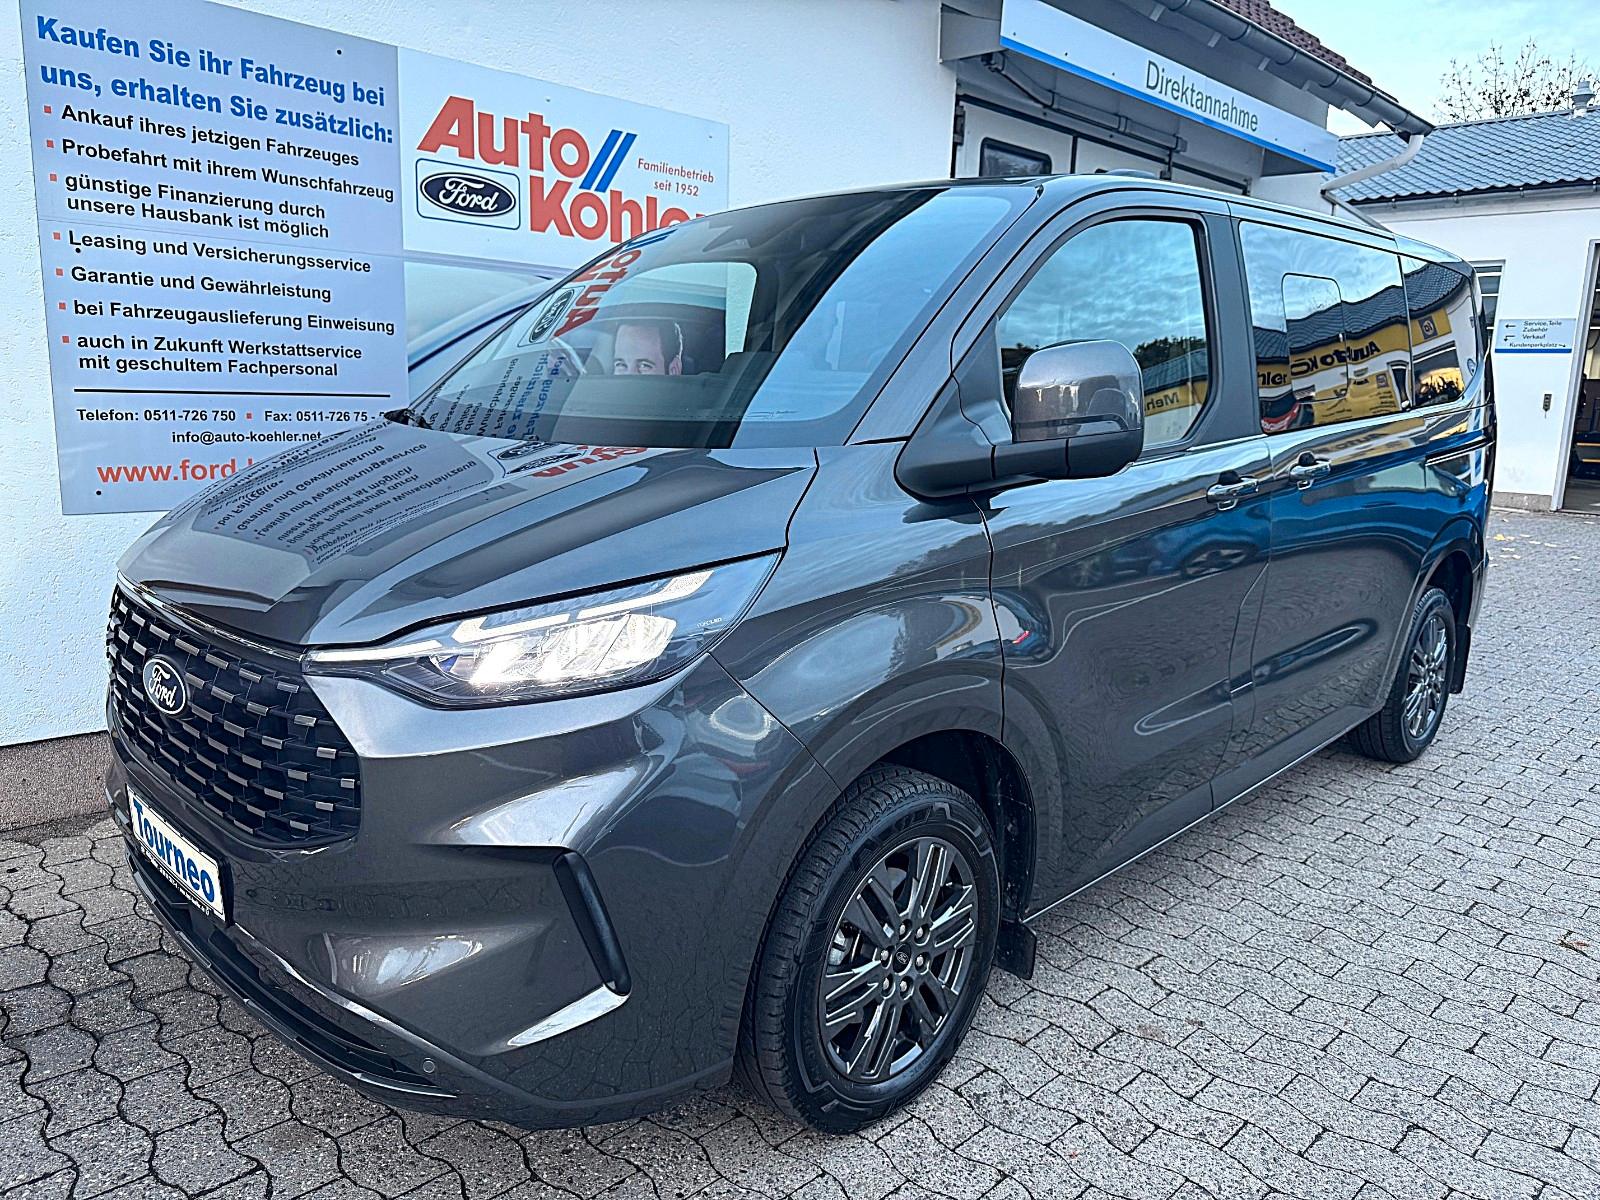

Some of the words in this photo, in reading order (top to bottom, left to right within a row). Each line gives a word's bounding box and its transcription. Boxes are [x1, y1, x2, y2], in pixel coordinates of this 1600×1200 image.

[37, 15, 139, 57] Kaufen
[149, 40, 190, 67] Sie
[199, 50, 232, 75] ihr
[240, 58, 345, 102] Fahrzeug
[353, 81, 384, 106] bei
[41, 65, 101, 97] uns,
[111, 77, 222, 113] erhalten
[230, 96, 268, 120] Sie
[275, 108, 393, 143] zusätzlich:
[1146, 60, 1258, 132] Direktannahme
[61, 105, 133, 130] Ankauf
[140, 118, 186, 138] ihres
[192, 126, 261, 151] jetzigen
[266, 138, 359, 167] Fahrzeuges
[417, 95, 590, 178] Auto
[62, 139, 167, 168] Probefahrt
[173, 157, 201, 173] mit
[207, 161, 256, 180] ihrem
[262, 168, 394, 201] Wunschfahrzeug
[638, 157, 714, 183] Familienbetrieb
[654, 180, 671, 192] seit
[675, 182, 699, 198] 1952
[65, 174, 152, 198] günstige
[158, 184, 273, 215] Finanzierung
[279, 200, 325, 218] durch
[439, 176, 499, 211] Ford
[67, 198, 135, 217] unsere
[142, 203, 233, 227] Hausbank
[238, 214, 259, 230] ist
[264, 218, 329, 239] möglich
[69, 230, 146, 254] Leasing
[153, 240, 187, 255] und
[193, 244, 371, 272] Versicherungsservice
[71, 266, 154, 286] Garantie
[160, 275, 195, 290] und
[200, 277, 331, 302] Gewährleistung
[74, 300, 103, 316] bei
[110, 303, 302, 330] Fahrzeugauslieferung
[308, 315, 395, 335] Einweisung
[77, 334, 124, 348] auch
[131, 336, 148, 350] in
[154, 336, 224, 353] Zukunft
[228, 340, 362, 359] Werkstattservice
[79, 356, 110, 370] mit
[116, 357, 222, 373] geschultem
[228, 360, 338, 377] Fachpersonal
[76, 409, 139, 421] Telefon:
[144, 410, 208, 422] 0511-726
[212, 410, 236, 422] 750
[265, 410, 292, 422] Fax:
[296, 411, 350, 422] 0511-726
[354, 411, 368, 422] 75
[172, 431, 322, 444] info@auto-koehler.net
[149, 665, 178, 708] Ford
[133, 798, 215, 902] Tourneo
